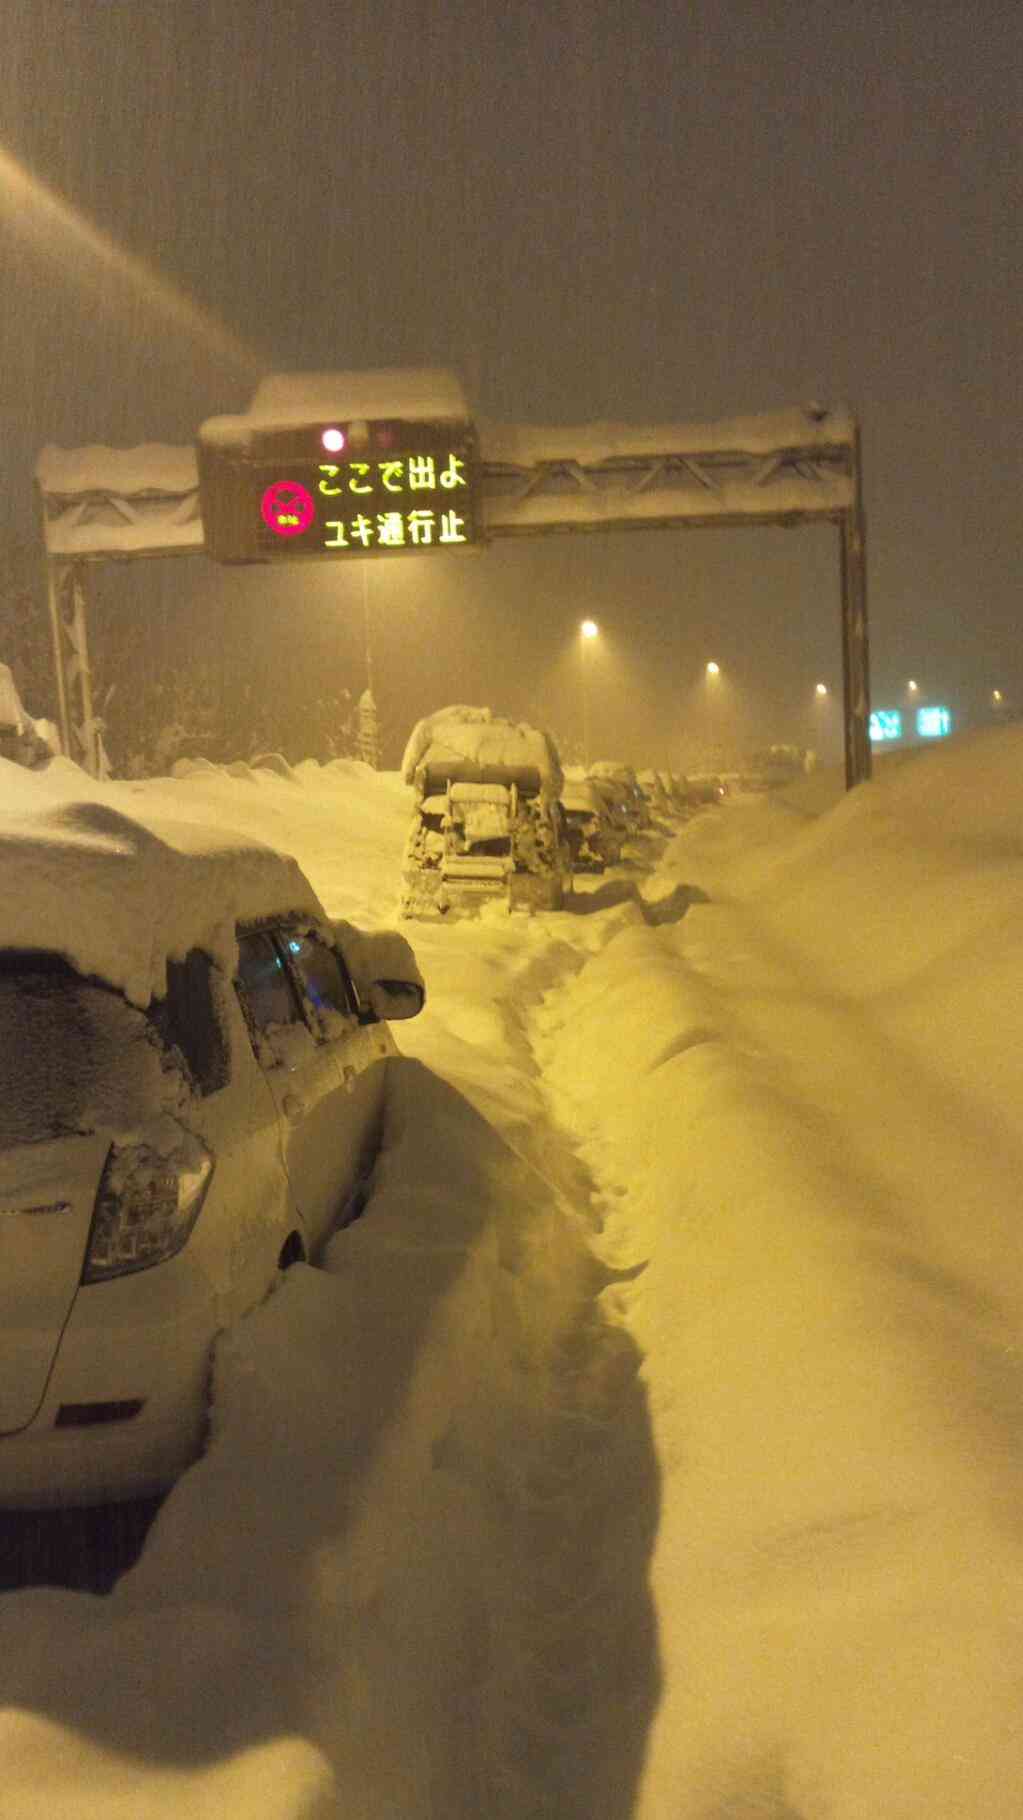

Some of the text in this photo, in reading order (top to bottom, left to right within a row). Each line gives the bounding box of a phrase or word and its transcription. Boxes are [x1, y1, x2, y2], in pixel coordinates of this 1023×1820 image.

[318, 453, 466, 496] ここで出よ
[324, 509, 467, 547] ユキ通行止
